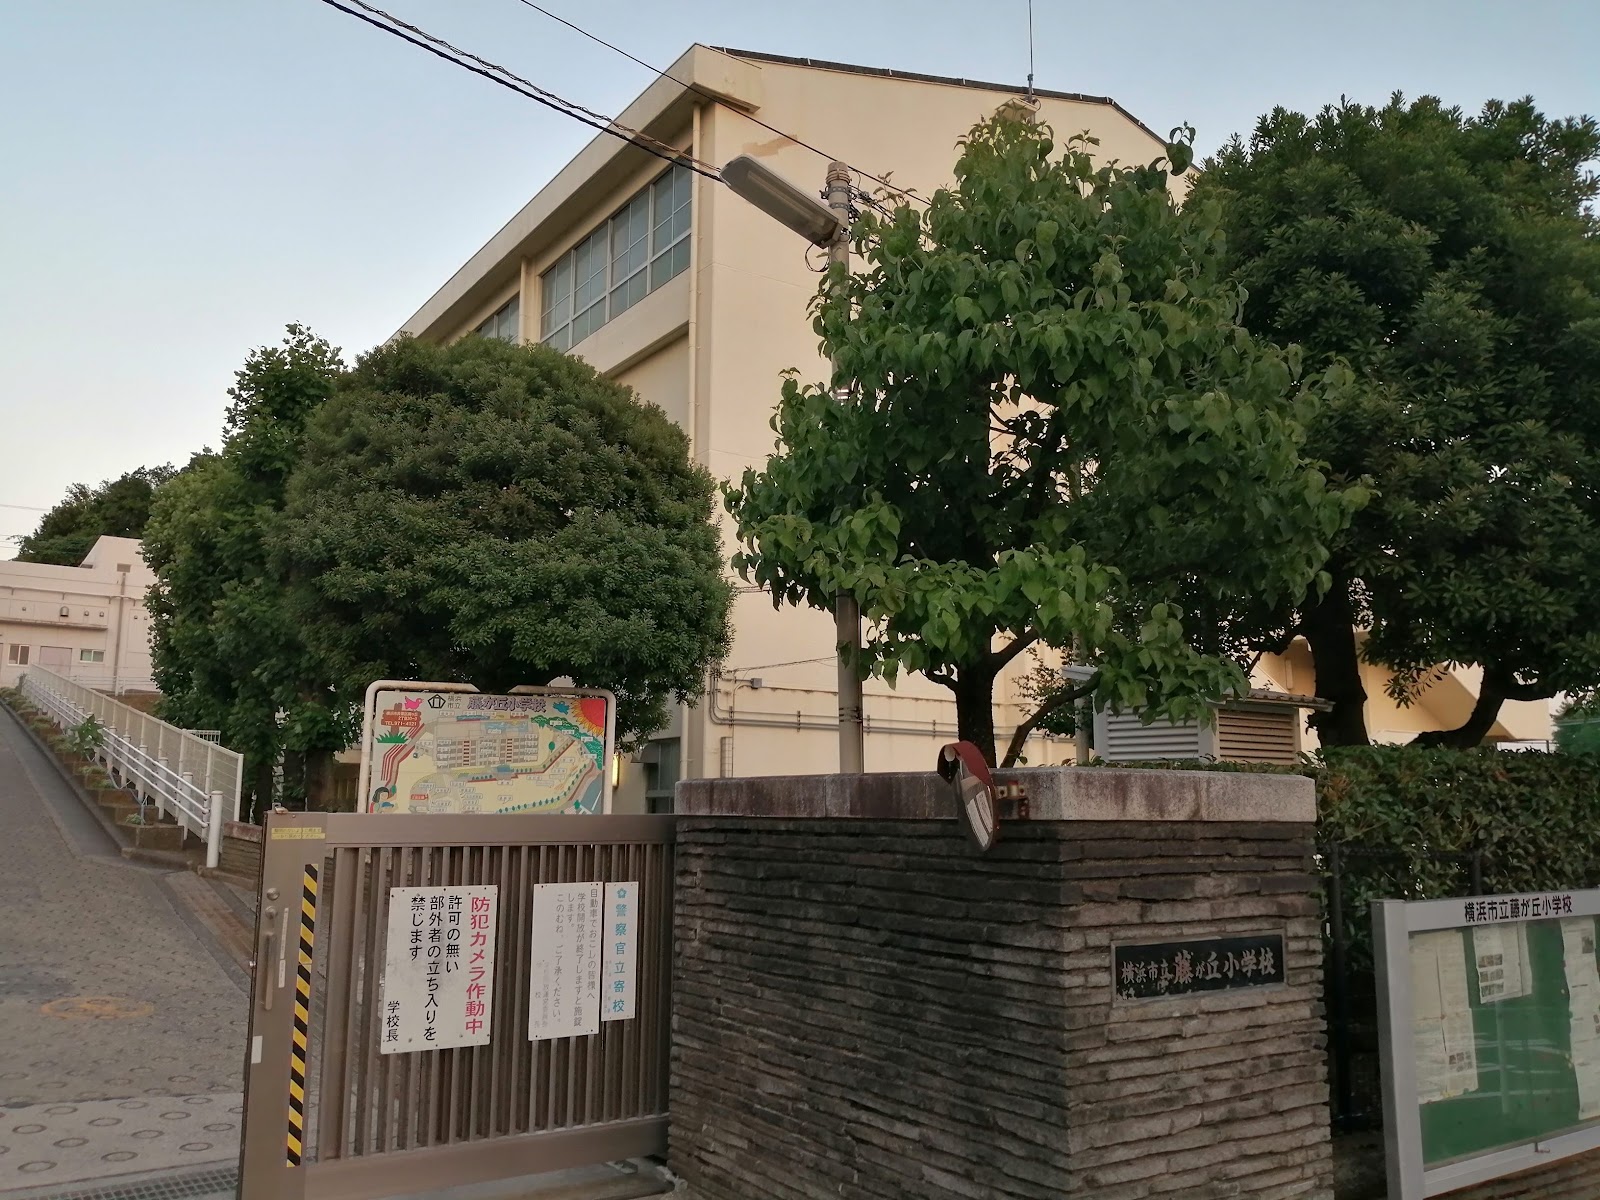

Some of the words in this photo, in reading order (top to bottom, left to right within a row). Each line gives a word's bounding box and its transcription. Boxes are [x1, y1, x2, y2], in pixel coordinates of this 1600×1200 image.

[467, 696, 546, 713] 藤が丘小学校
[409, 896, 426, 961] 禁じます
[446, 896, 463, 973] 許可の無い
[567, 893, 575, 928] します。
[586, 888, 599, 999] 自動車でおこしの皆様へ
[1464, 895, 1572, 923] 横浜市立藤が丘小学校
[424, 896, 444, 1041] 部外者の立ち入りを
[465, 896, 490, 1034] 防犯カメラ作動中
[573, 893, 586, 1027] 学校開放が終了しますと施錠
[612, 904, 627, 1012] 警察官立寄校
[1121, 947, 1276, 985] 横浜市立藤が丘小学校
[386, 1000, 400, 1042] 学校長
